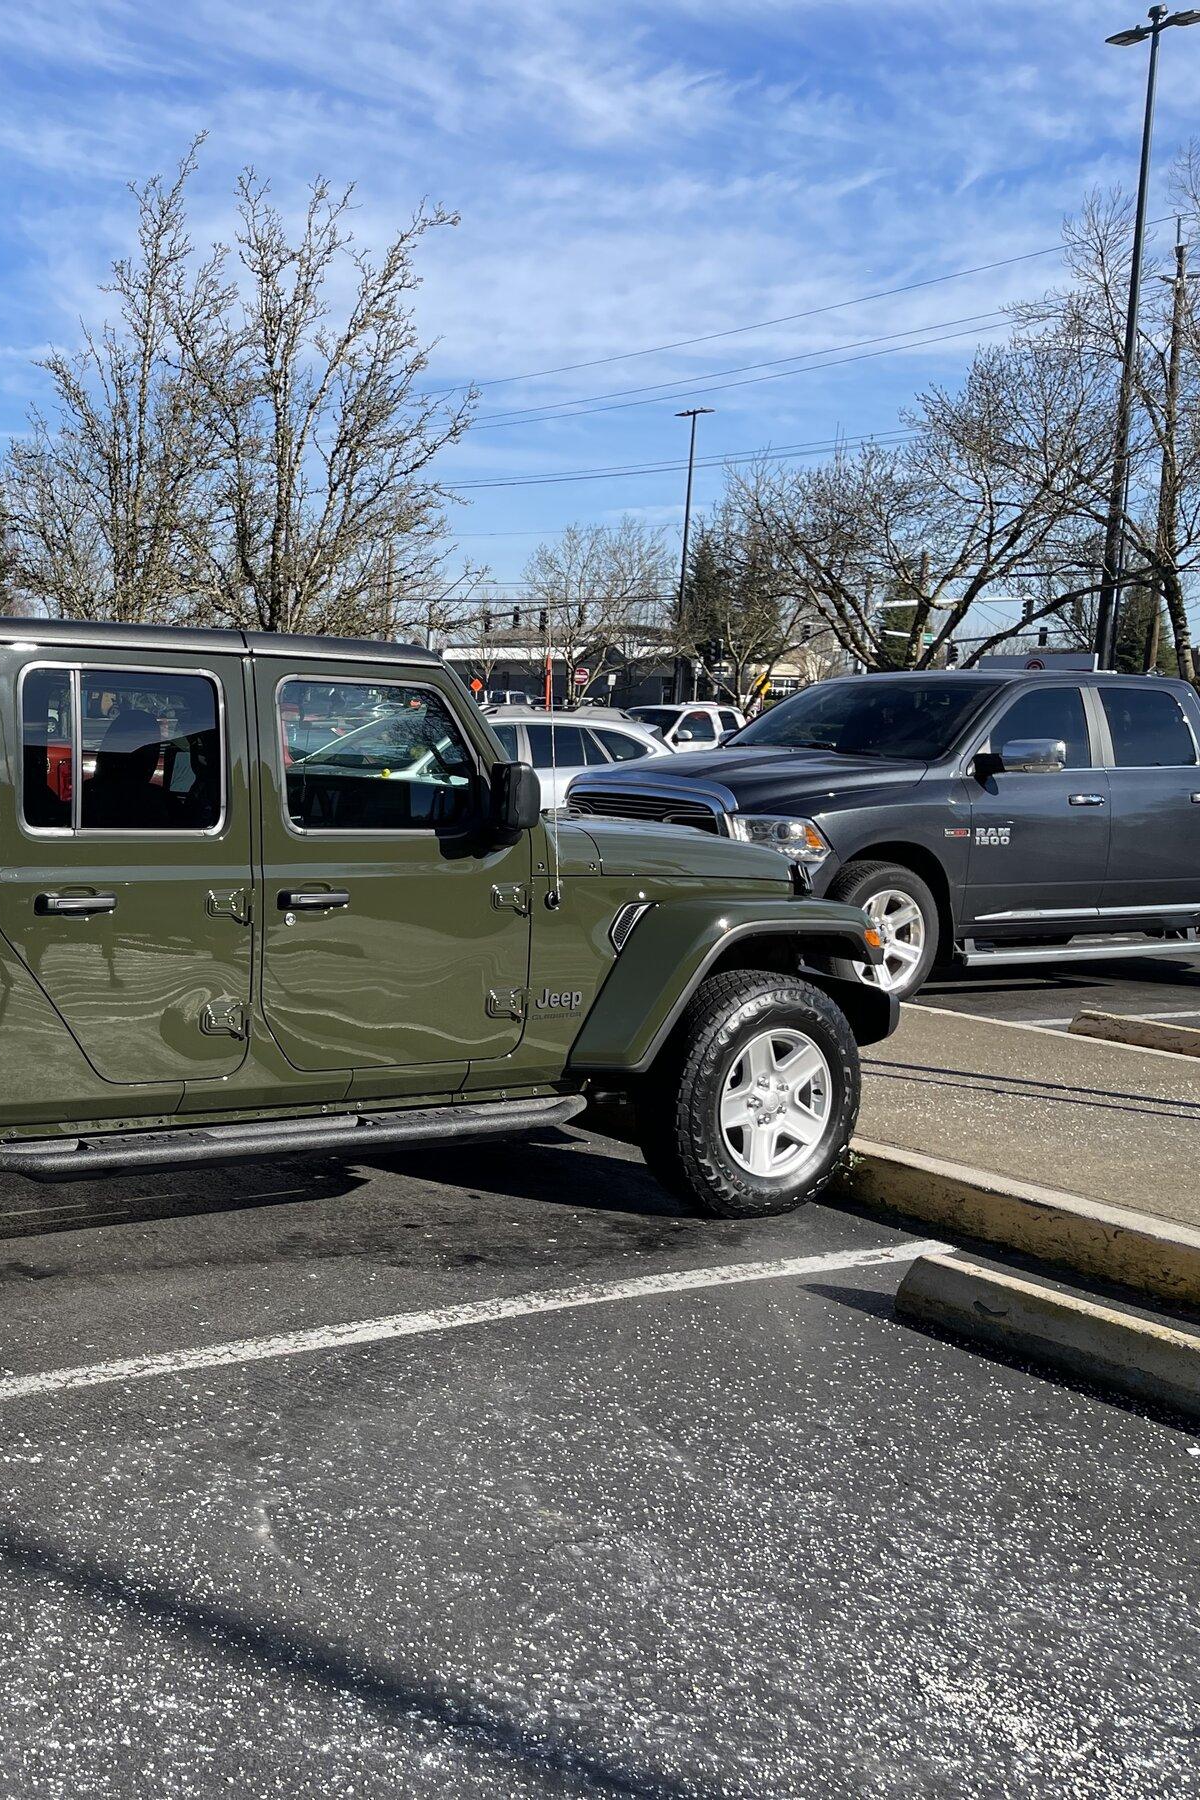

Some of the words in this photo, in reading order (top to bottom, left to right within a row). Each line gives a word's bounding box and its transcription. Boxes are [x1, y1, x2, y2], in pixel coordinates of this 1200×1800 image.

[975, 827, 1011, 837] RAM
[975, 836, 1010, 846] 1500
[535, 988, 583, 1010] Jeep
